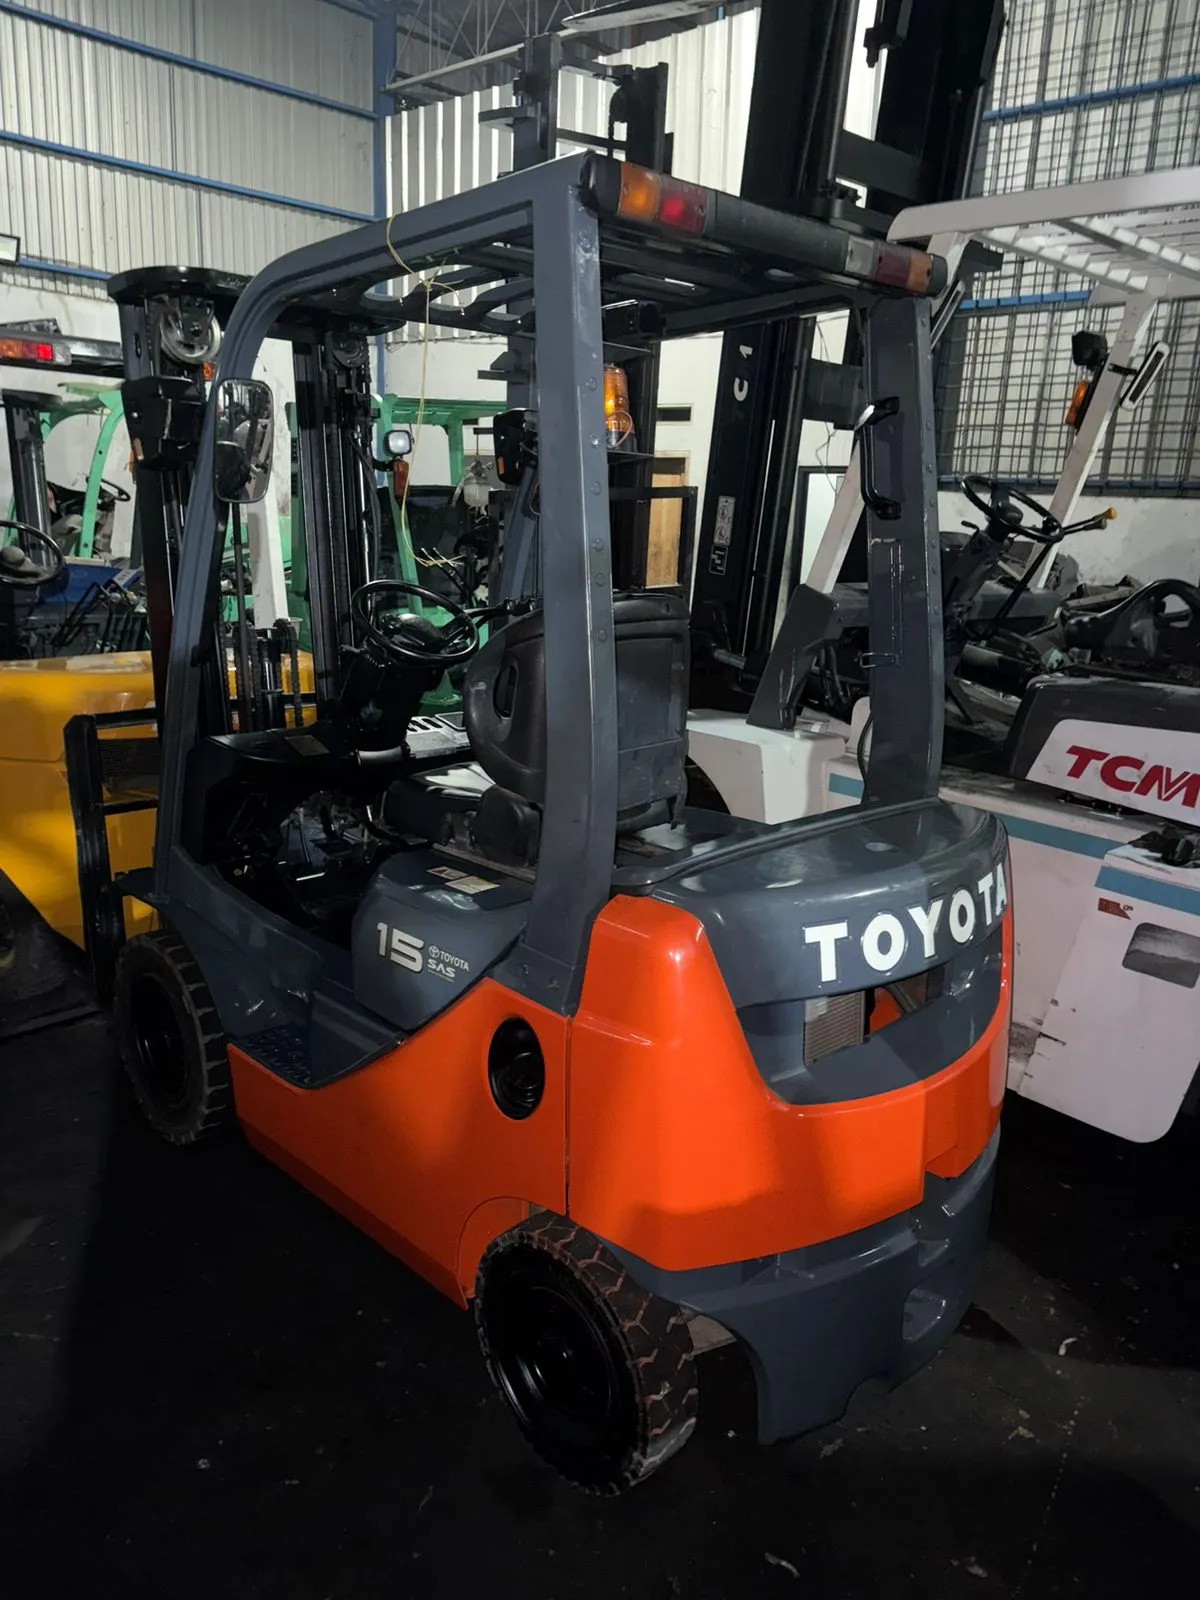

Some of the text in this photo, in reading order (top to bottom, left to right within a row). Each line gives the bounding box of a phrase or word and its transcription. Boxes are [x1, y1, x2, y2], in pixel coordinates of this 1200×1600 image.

[1066, 745, 1200, 808] TCM
[377, 922, 425, 972] 15
[804, 862, 1008, 982] TOYOTA
[427, 958, 456, 978] SAS
[439, 950, 470, 972] TOYOTA
